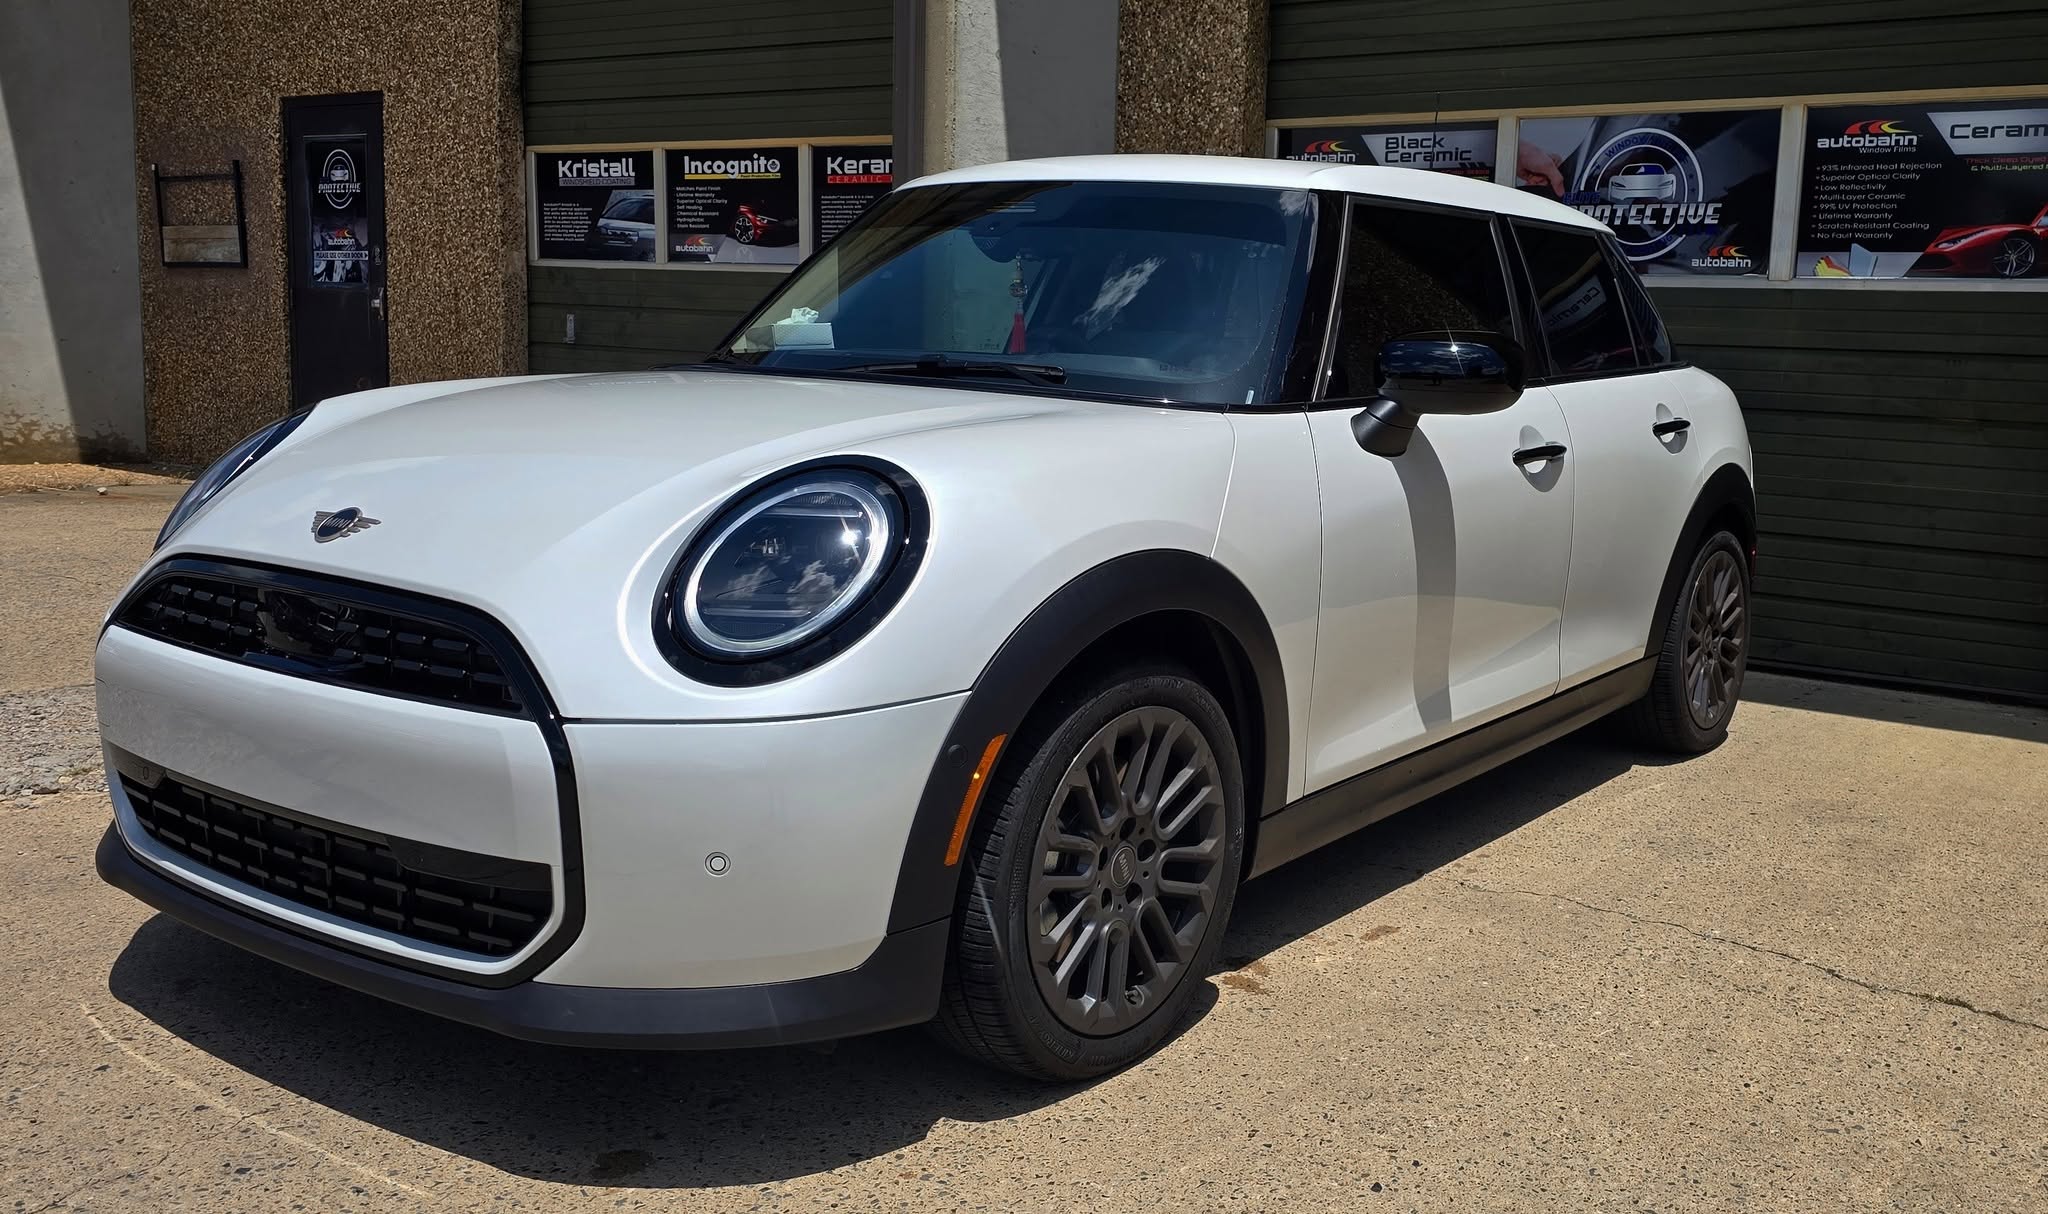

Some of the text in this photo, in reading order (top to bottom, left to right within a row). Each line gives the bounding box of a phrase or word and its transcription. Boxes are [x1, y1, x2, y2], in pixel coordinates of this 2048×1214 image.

[1950, 124, 2048, 138] Ceram
[1385, 134, 1445, 150] Black
[1816, 134, 1918, 148] autobahn
[1385, 147, 1472, 163] Ceramic
[558, 158, 635, 177] Kristall
[684, 152, 780, 178] Incognito
[1900, 162, 1942, 170] Rejection
[828, 175, 883, 183] CERAMIC
[1857, 173, 1891, 181] Optical
[1892, 172, 1920, 180] Clarity
[318, 182, 360, 193] PROTECTIVE
[1571, 203, 1722, 225] ROTECTIVE
[1892, 222, 1930, 230] Coating
[1691, 256, 1751, 267] autobahn
